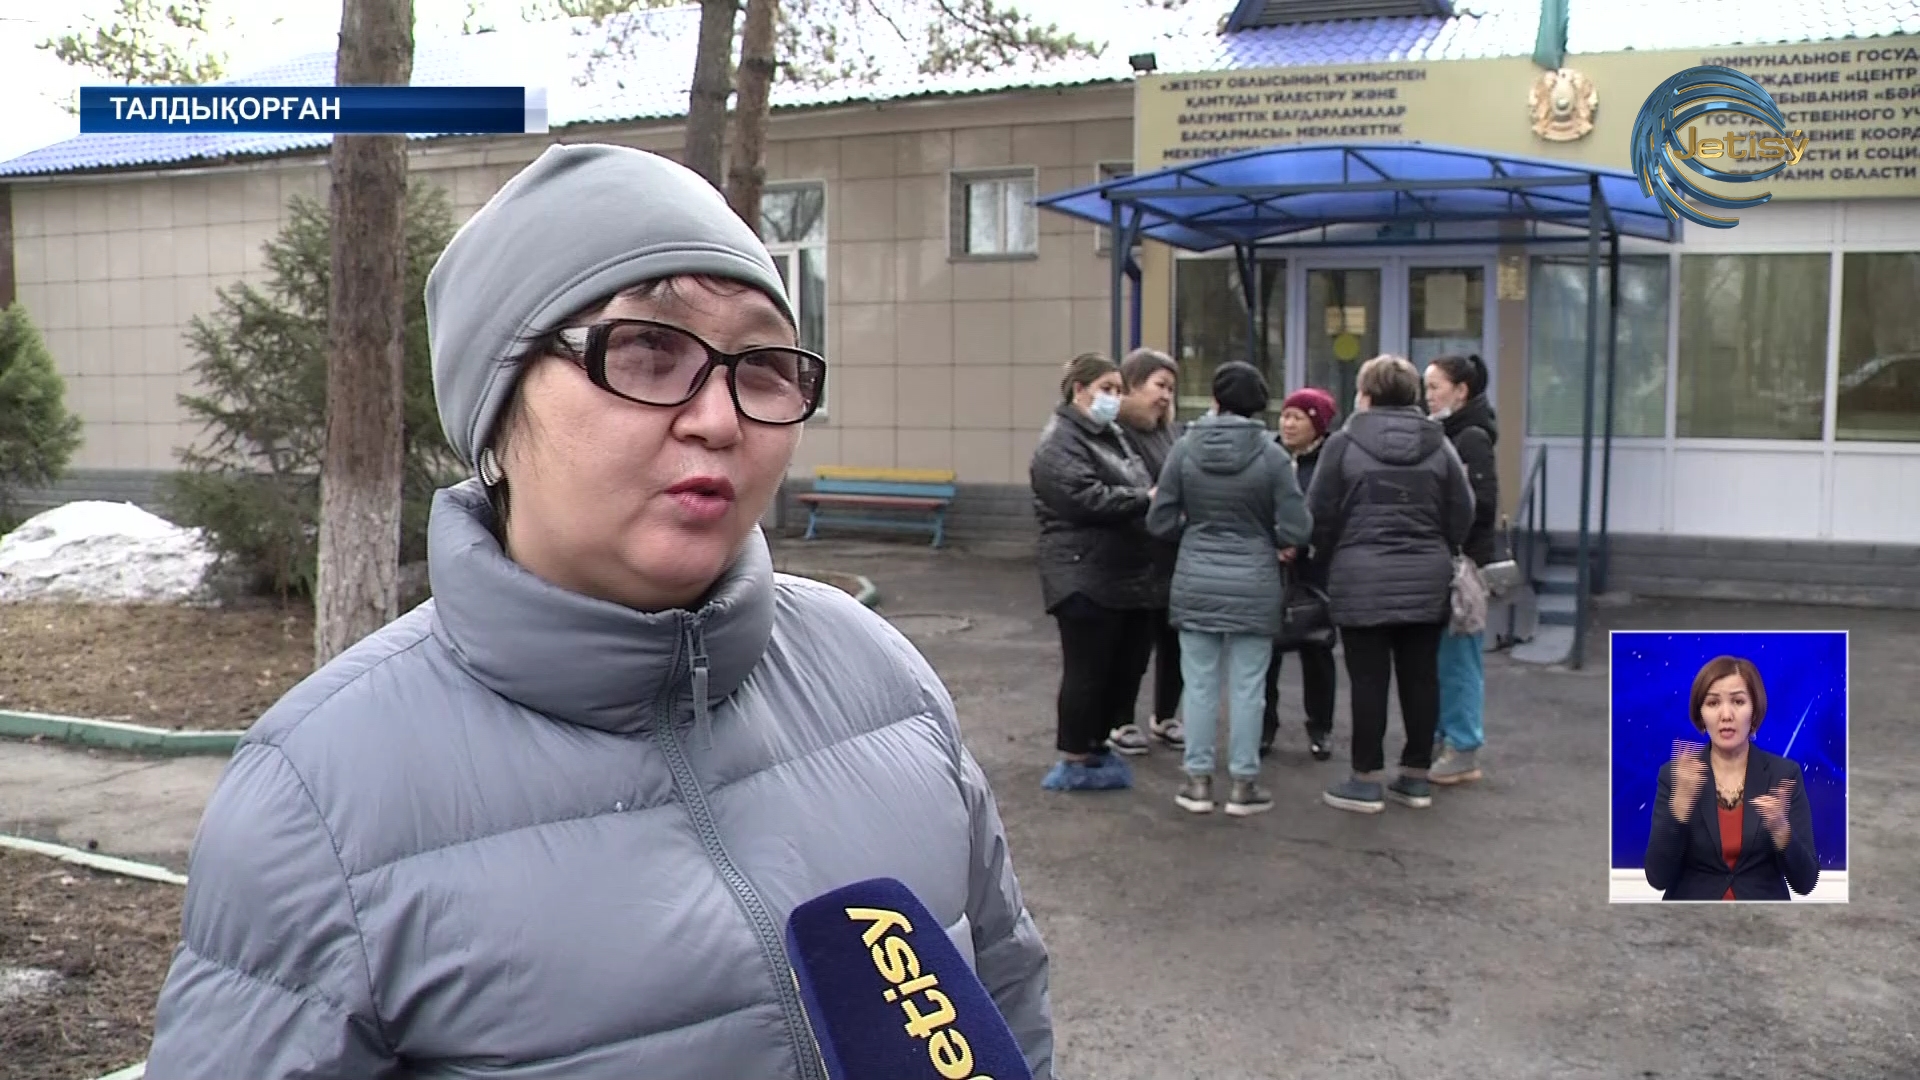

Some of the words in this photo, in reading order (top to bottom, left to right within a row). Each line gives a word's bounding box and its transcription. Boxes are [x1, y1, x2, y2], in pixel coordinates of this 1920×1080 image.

[1702, 51, 1851, 68] КОММУНАЛЬНОЕ
[1847, 148, 1858, 160] И
[1830, 166, 1917, 180] ОБЛАСТИ
[845, 908, 995, 1080] etisy
